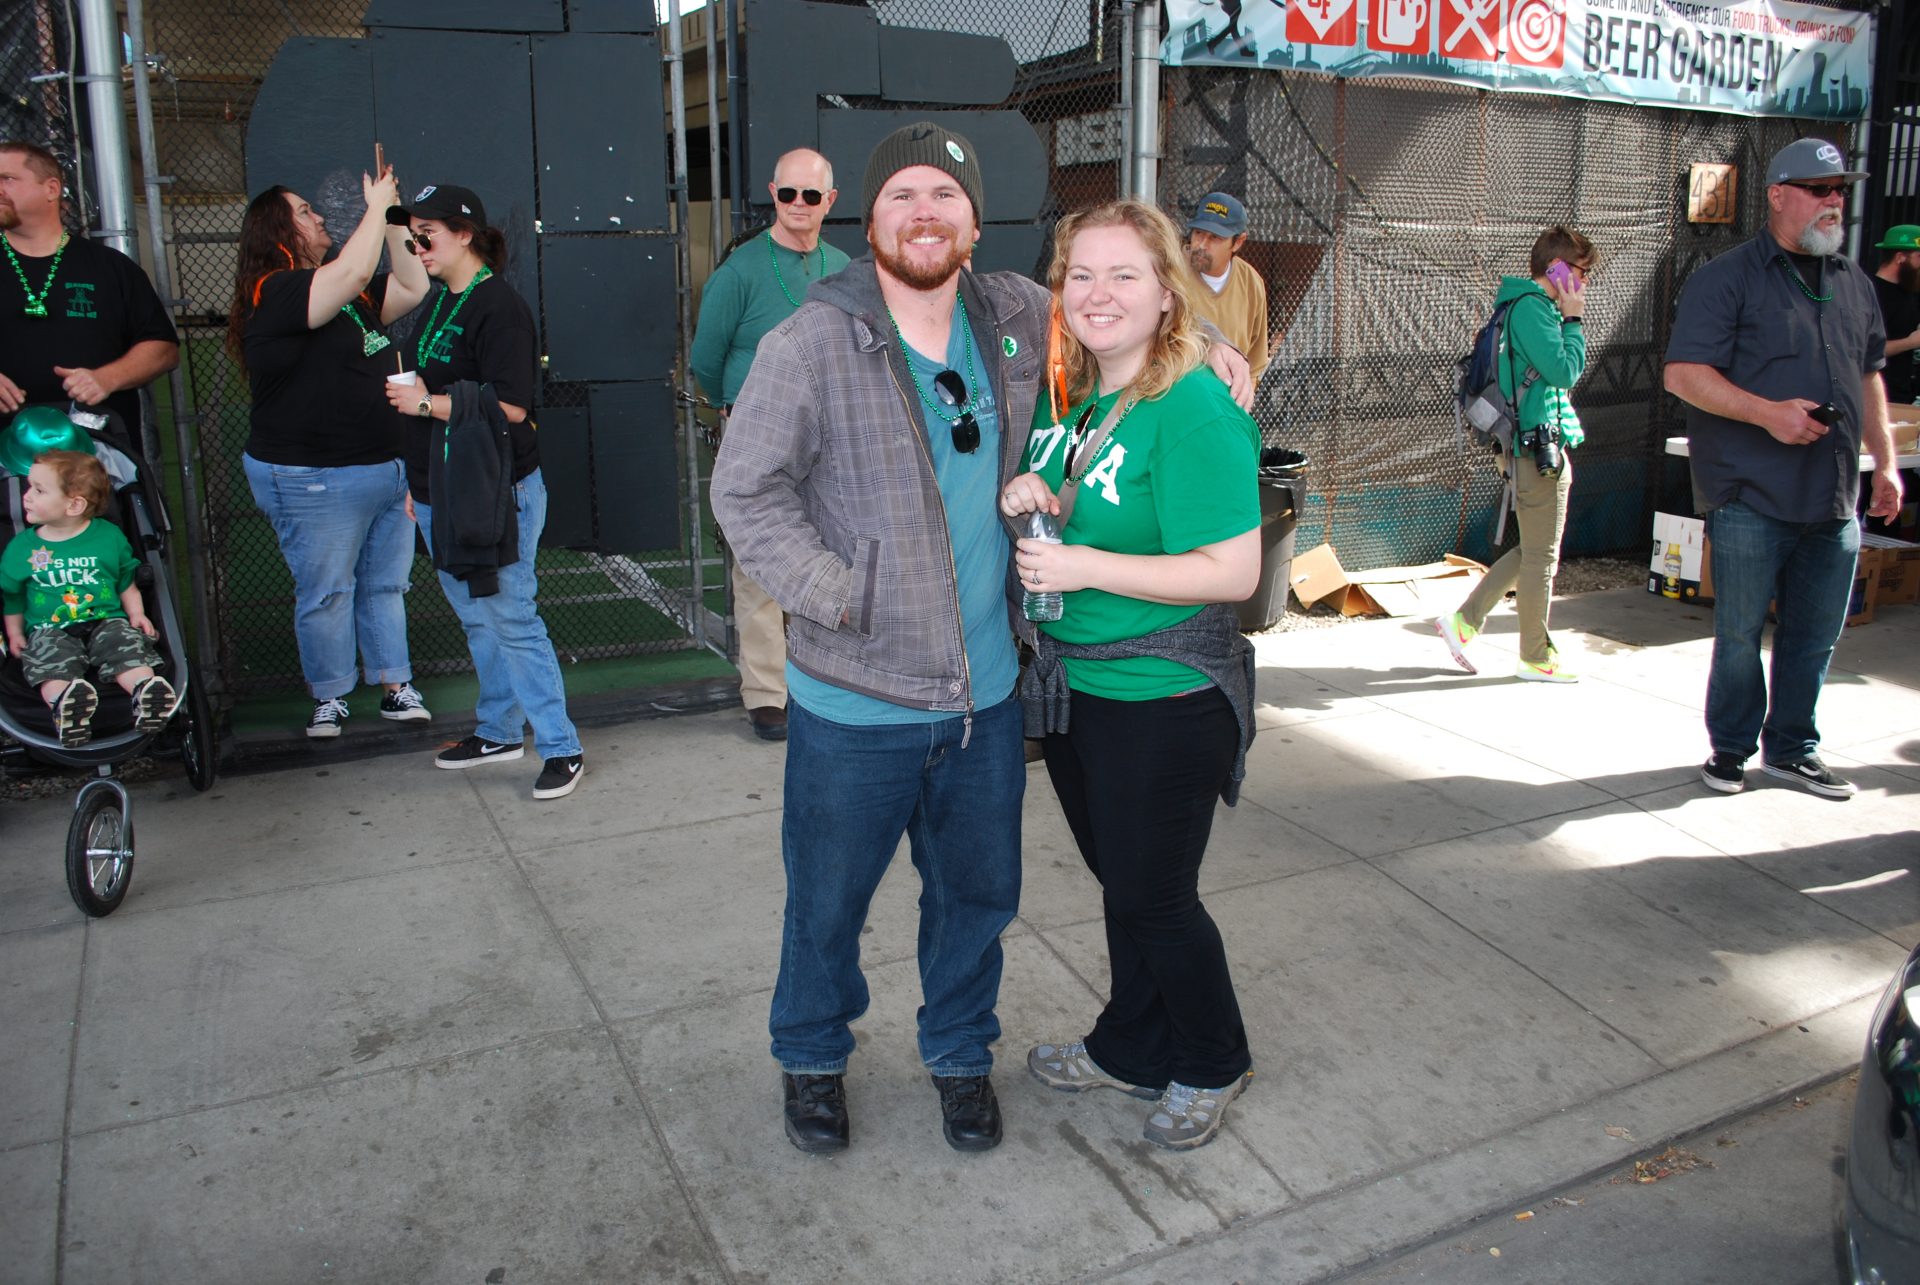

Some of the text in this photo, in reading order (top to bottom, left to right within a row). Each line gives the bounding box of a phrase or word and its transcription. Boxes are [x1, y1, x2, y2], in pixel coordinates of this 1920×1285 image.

[1618, 0, 1628, 12] IN
[1630, 0, 1650, 15] AND
[1653, 0, 1711, 25] EXPERIENCE
[1712, 8, 1731, 28] OUR
[1732, 11, 1756, 31] FOOD
[1758, 14, 1793, 38] TRUCKS,
[1794, 20, 1828, 41] DRINKS
[1828, 24, 1836, 42] &
[1836, 26, 1856, 45] FUN!
[1583, 12, 1784, 97] BEER GARDEN
[1691, 170, 1730, 218] 431
[31, 568, 100, 588] LUCK
[68, 556, 98, 568] NOT
